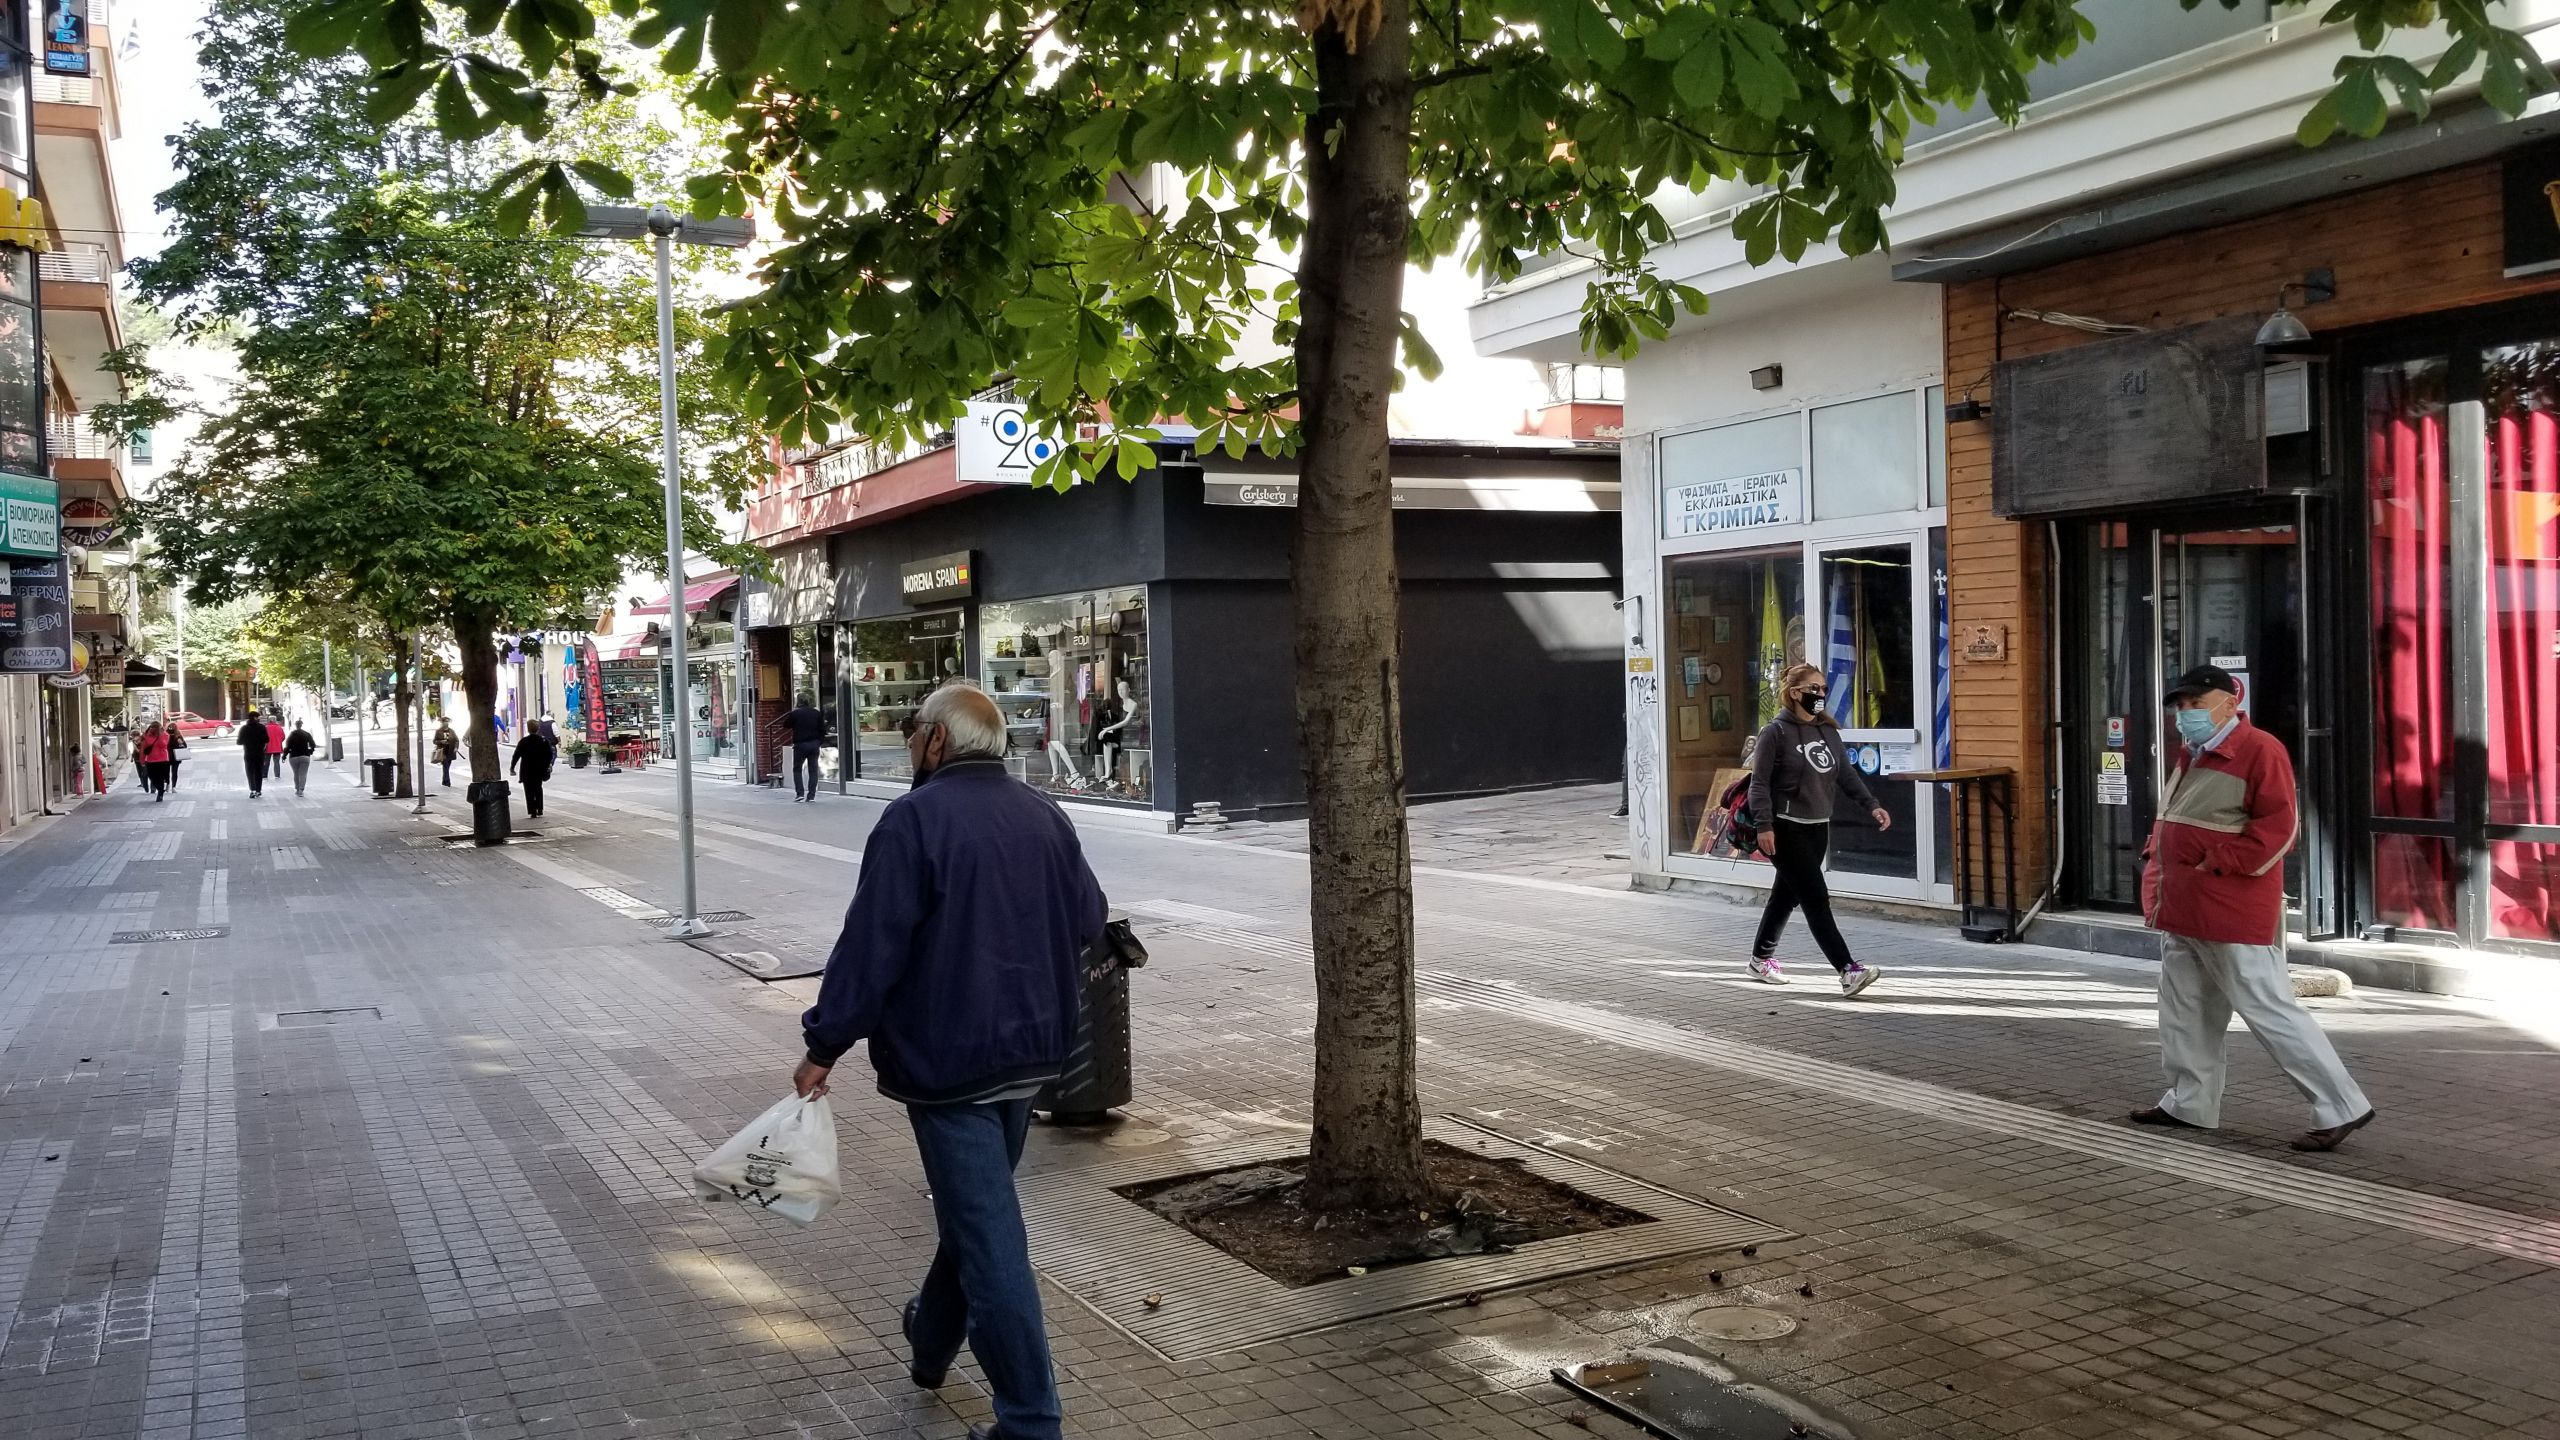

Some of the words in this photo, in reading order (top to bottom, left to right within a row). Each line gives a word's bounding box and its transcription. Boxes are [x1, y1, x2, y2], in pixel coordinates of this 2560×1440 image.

[1239, 485, 1286, 505] Carlsberg
[1679, 482, 1728, 500] ΥΦΑΣΜΑΤΑ
[1743, 473, 1787, 490] ΙΕΡΑΤΙΚΑ
[1685, 488, 1777, 512] ΕΚΚΛΗΣΙΑΣΤΙΚΑ
[10, 504, 55, 525] ΒΙΟΜΟΡΙΑΚΗ
[12, 528, 55, 547] ΑΠΕΙΚΟΝΙΣΗ
[903, 571, 934, 594] MORENA
[935, 566, 959, 588] SPAIN
[11, 585, 66, 604] ΑΒΕΡΝΑ
[12, 649, 57, 657] ΑΝΟΙΧΤΑ
